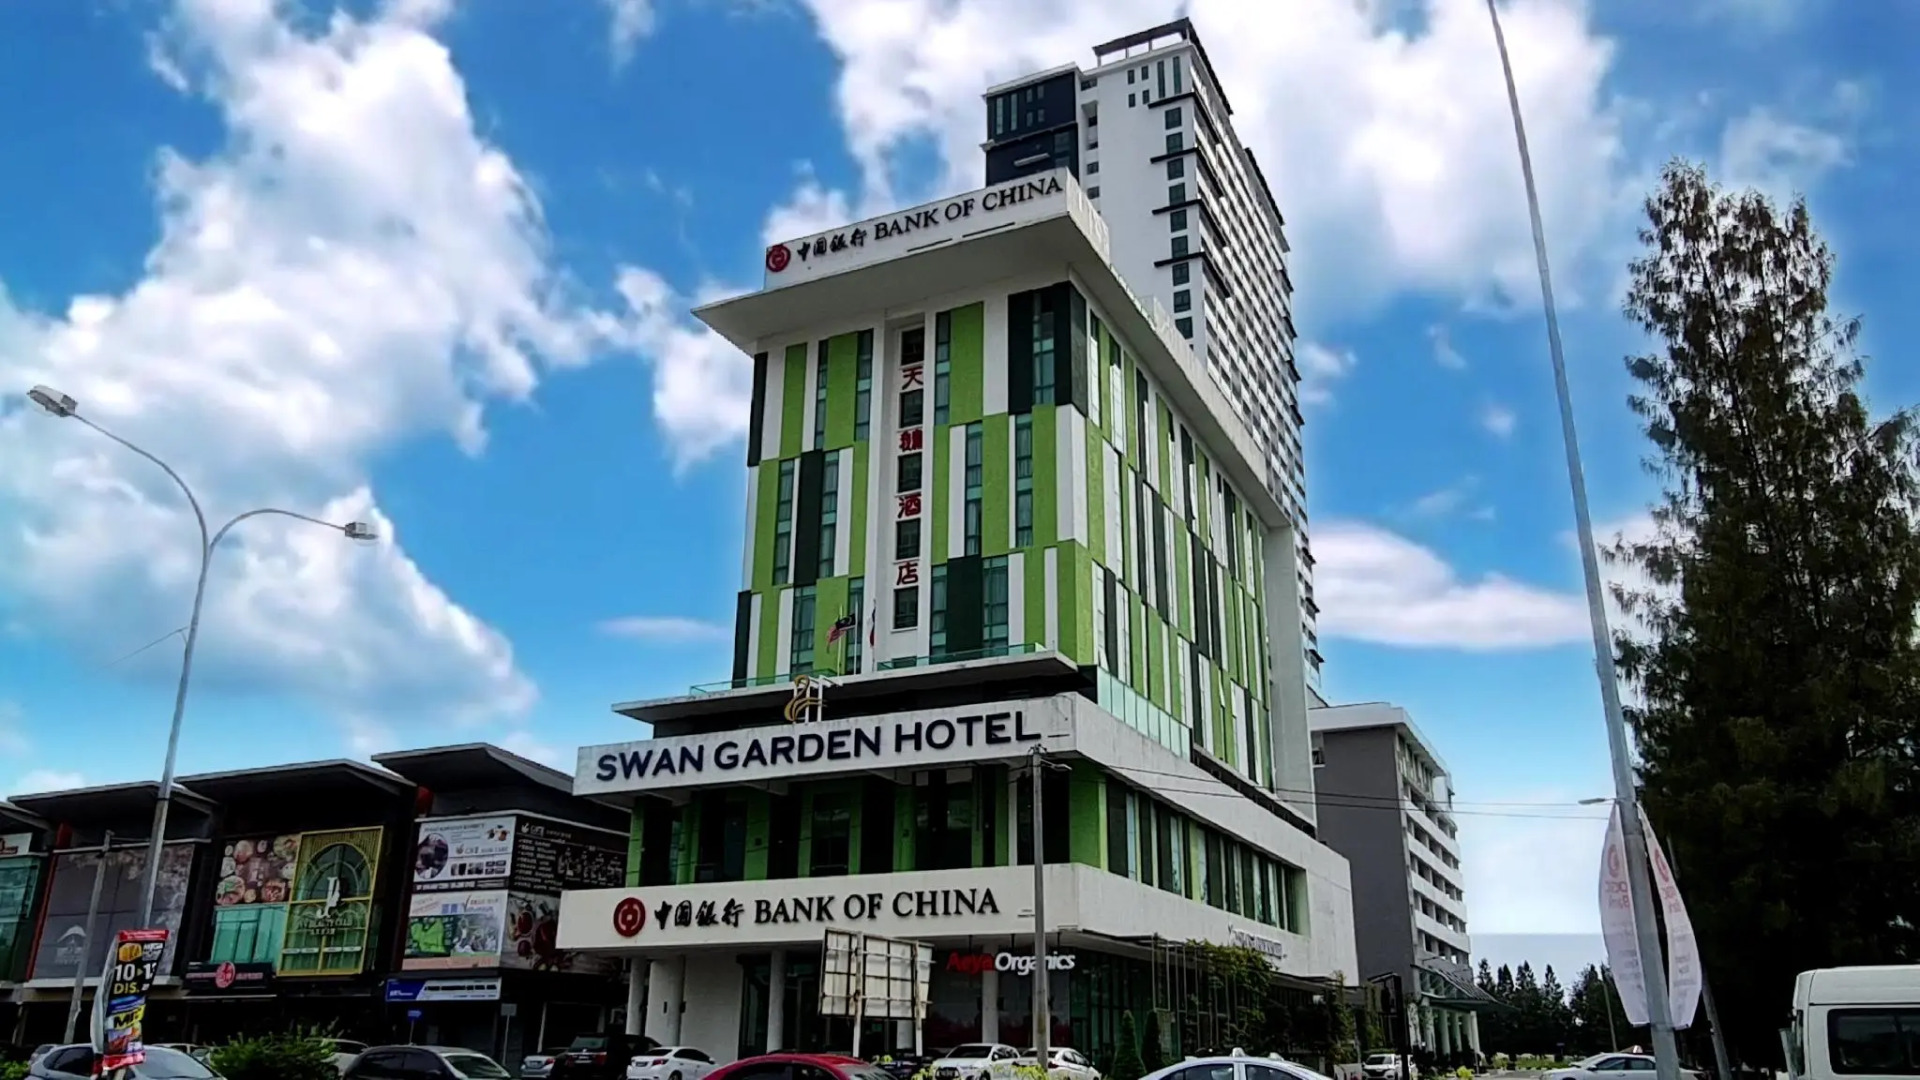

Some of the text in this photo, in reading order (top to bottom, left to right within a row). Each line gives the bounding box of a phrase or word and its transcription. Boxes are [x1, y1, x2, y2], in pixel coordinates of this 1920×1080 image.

[874, 208, 939, 241] BANK
[944, 198, 975, 220] OF
[981, 176, 1063, 211] CHINA
[596, 710, 1042, 782] SWAN GARDEN HOTEL
[754, 896, 835, 924] BANK
[843, 893, 883, 920] OF
[892, 888, 1000, 918] CHINA
[113, 981, 140, 995] DIS.
[115, 963, 136, 982] 10
